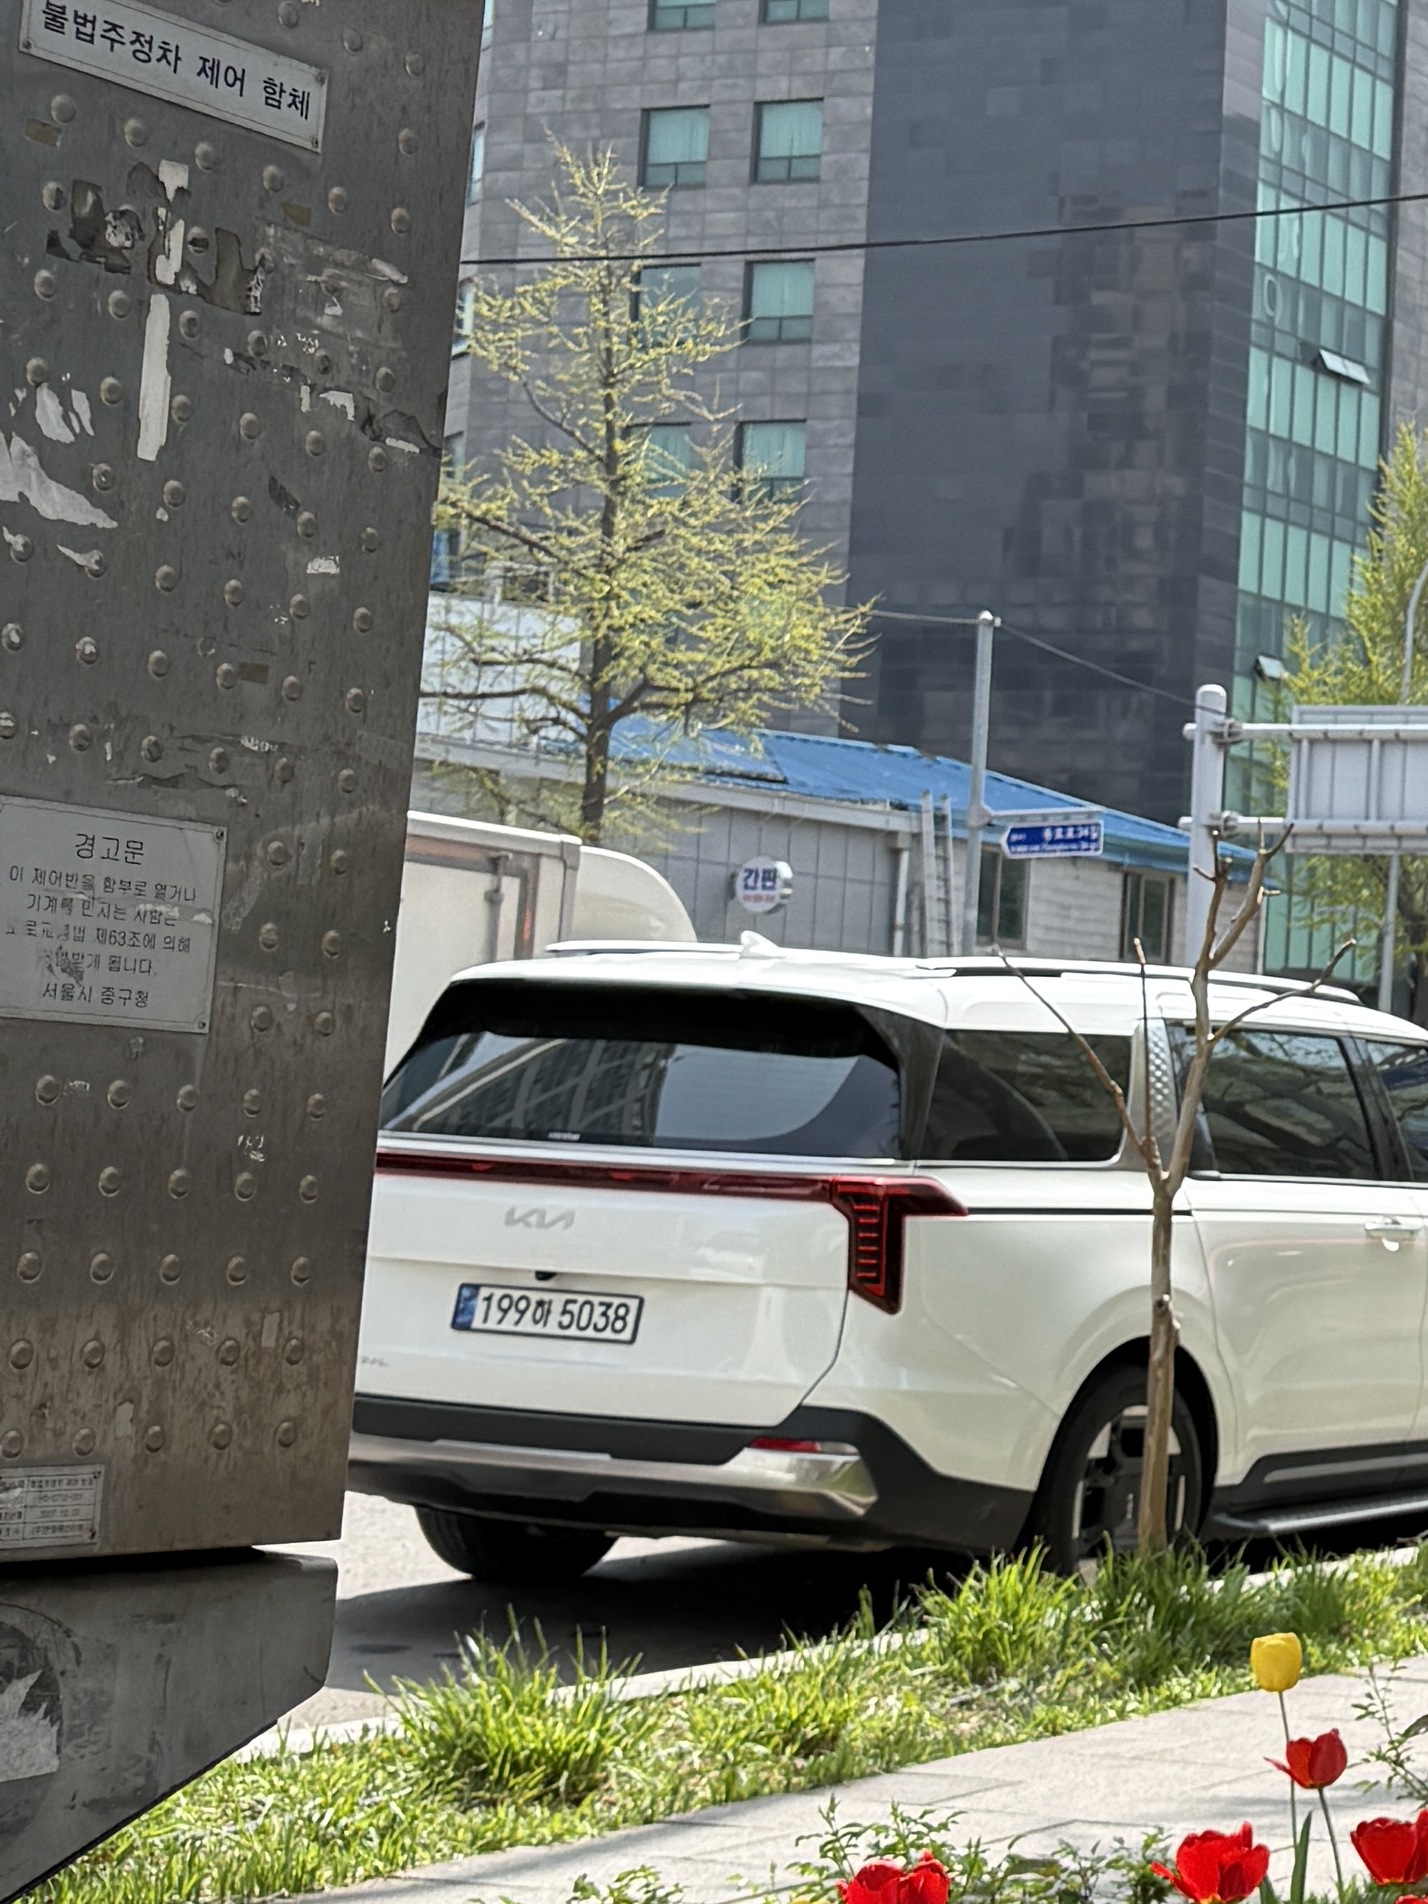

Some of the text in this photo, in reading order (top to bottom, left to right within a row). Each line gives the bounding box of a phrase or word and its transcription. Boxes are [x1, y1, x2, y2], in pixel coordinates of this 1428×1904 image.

[41, 0, 311, 120] 불법주정차 제어 함체
[75, 832, 145, 866] 경고문
[9, 865, 24, 883] 이
[41, 982, 93, 1004] 서울시
[481, 1291, 631, 1335] 199하 5038
